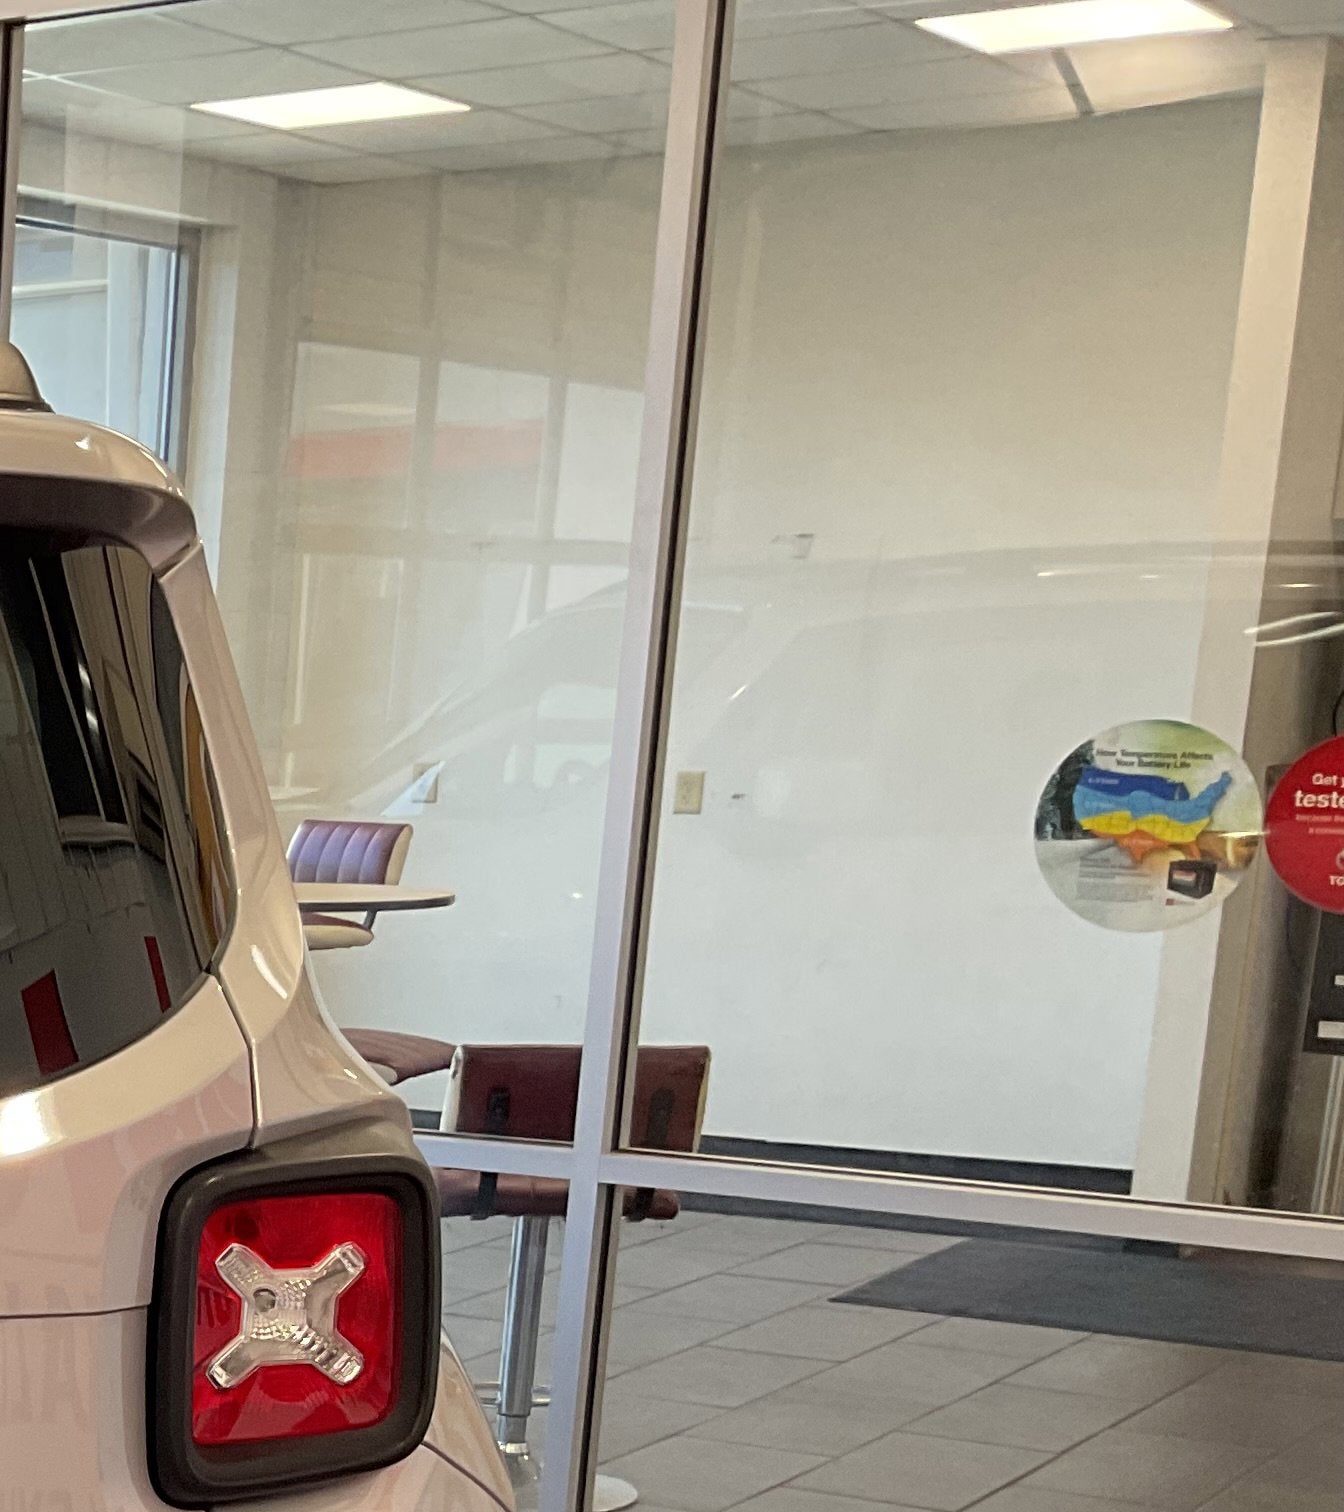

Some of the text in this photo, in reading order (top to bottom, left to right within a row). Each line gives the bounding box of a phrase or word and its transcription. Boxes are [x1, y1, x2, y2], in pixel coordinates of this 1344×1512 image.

[1119, 749, 1178, 759] Temperature
[1115, 759, 1135, 767] Your
[1137, 759, 1171, 770] Battery
[1311, 772, 1338, 786] Get
